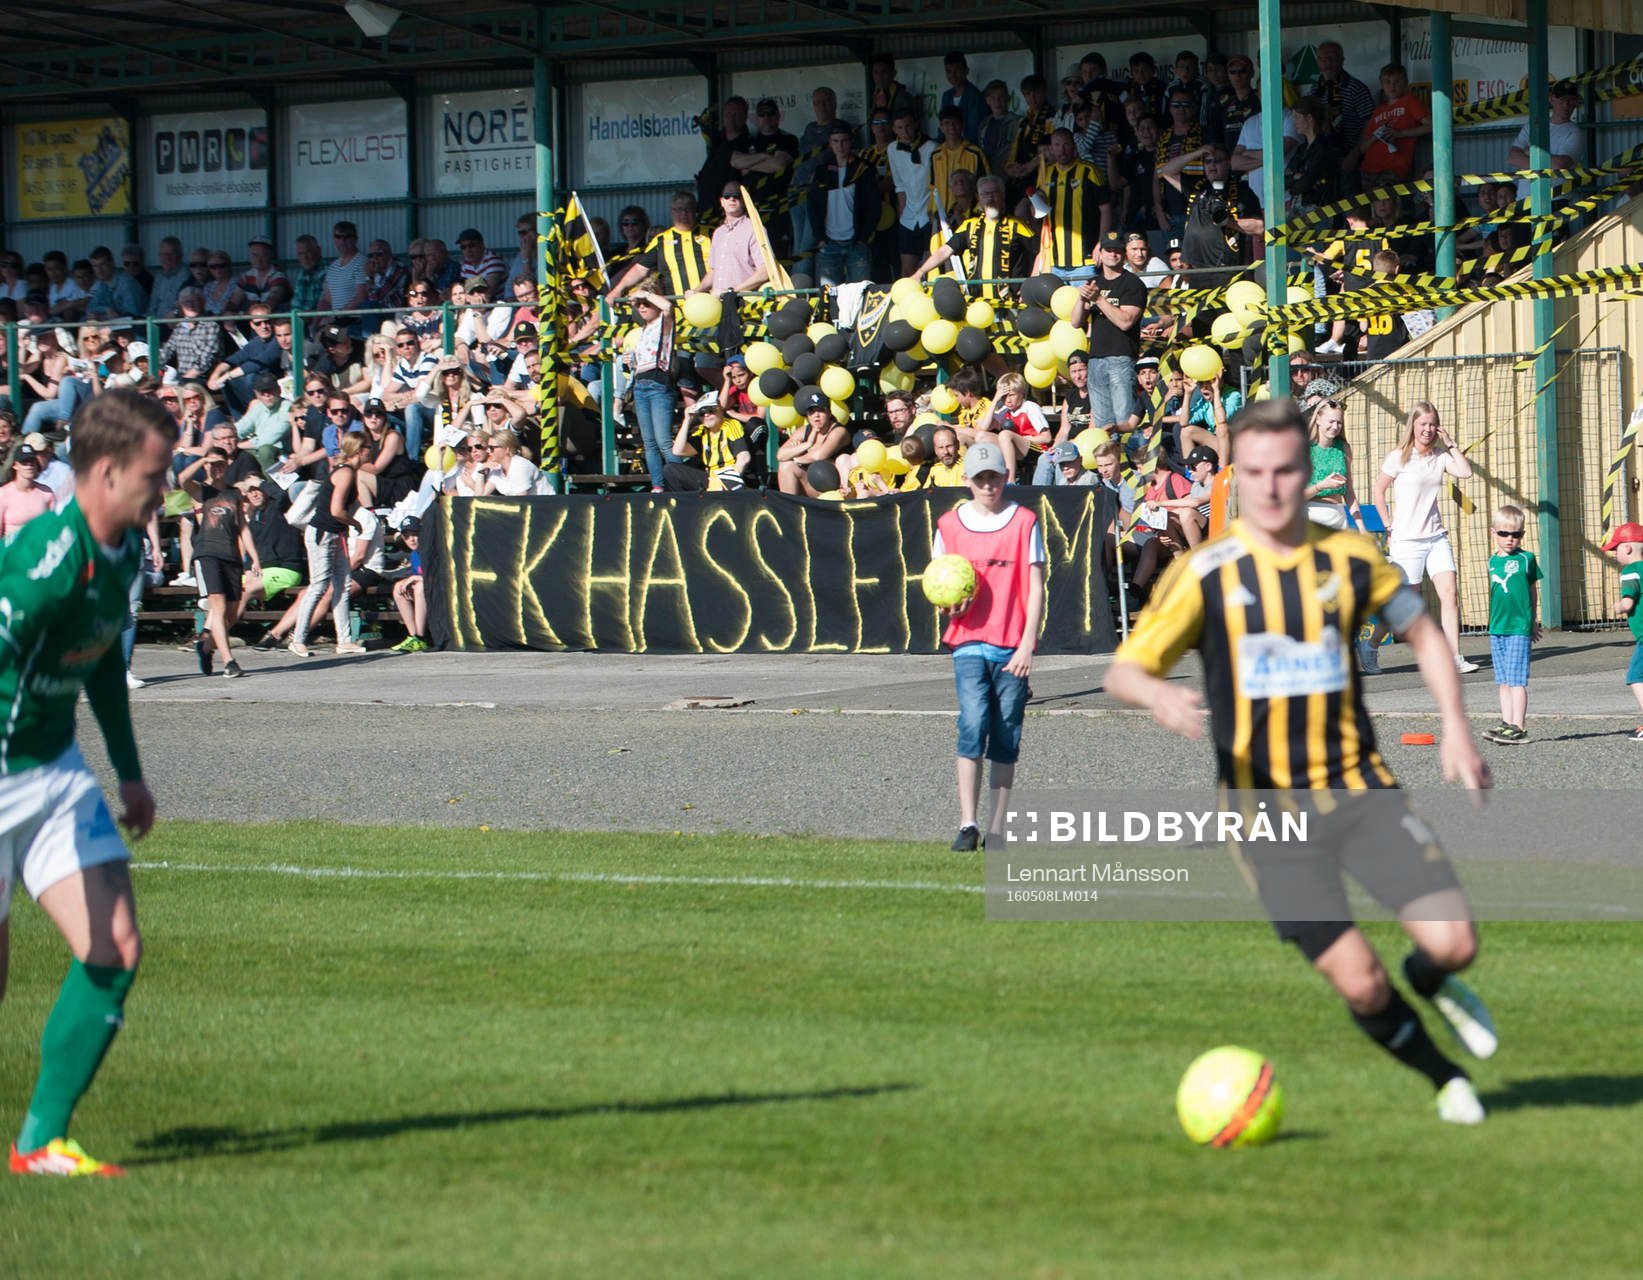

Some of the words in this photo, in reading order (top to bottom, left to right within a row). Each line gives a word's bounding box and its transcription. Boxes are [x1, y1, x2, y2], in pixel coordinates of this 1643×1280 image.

[443, 101, 536, 146] NORÉ
[589, 110, 700, 141] Handelsbanke
[298, 133, 406, 166] FLEXILAST
[444, 155, 532, 174] FASTIGHET
[1367, 314, 1393, 336] 10
[583, 491, 1095, 654] HÄSSLEHM
